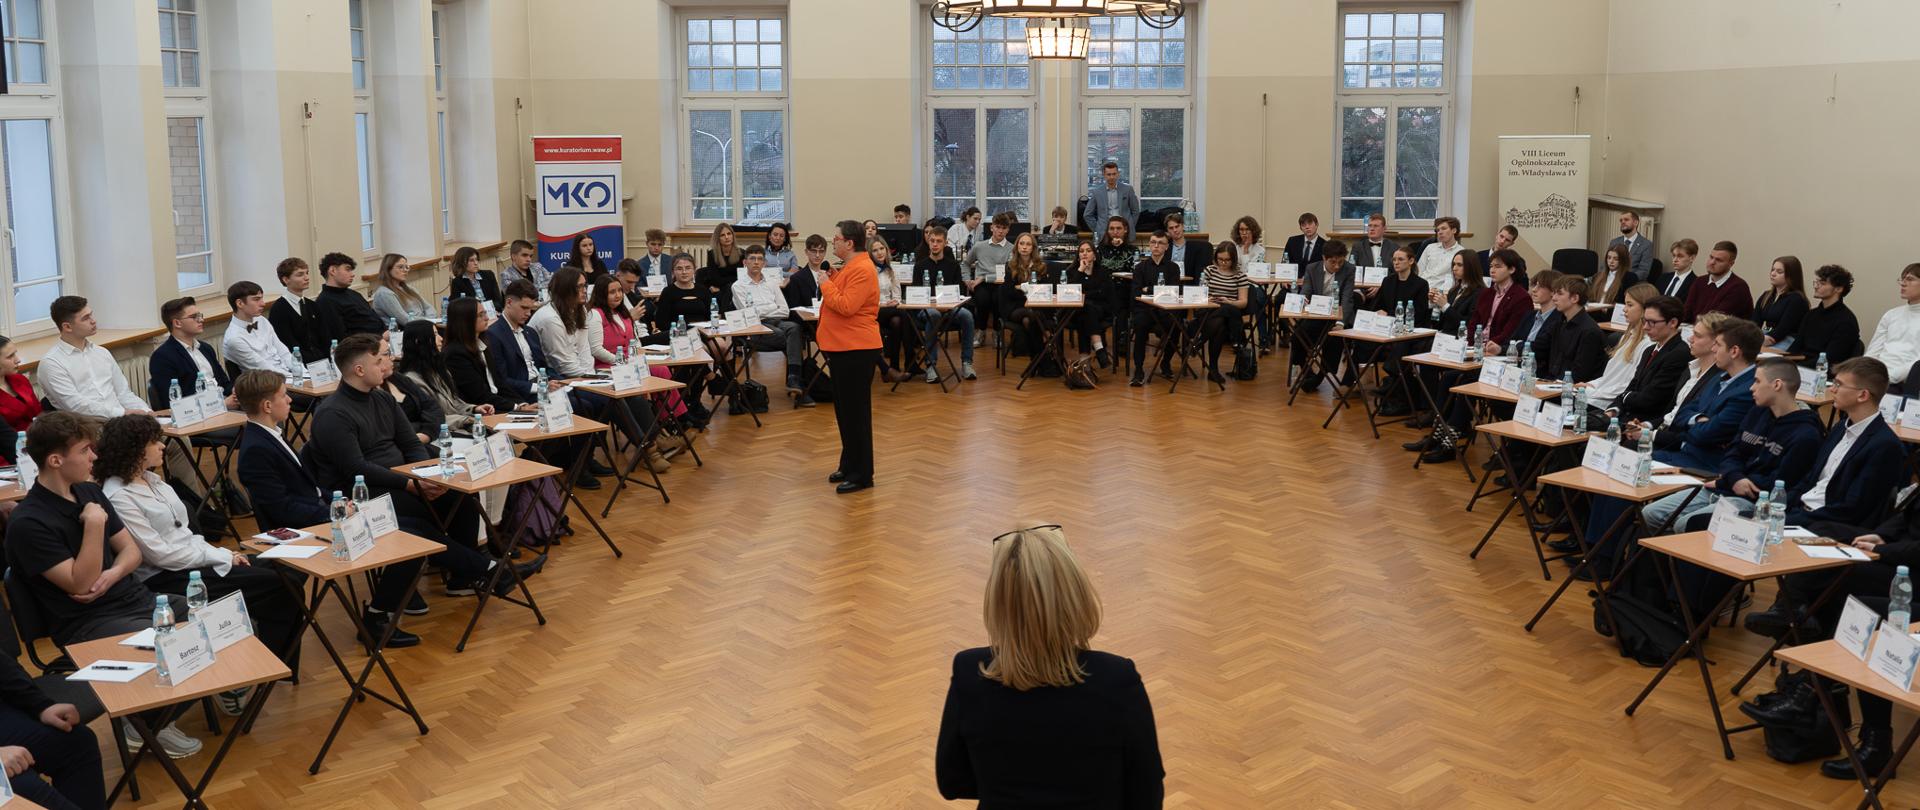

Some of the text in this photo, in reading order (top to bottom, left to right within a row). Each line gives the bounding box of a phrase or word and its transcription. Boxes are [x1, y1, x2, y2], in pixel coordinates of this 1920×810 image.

[1511, 159, 1576, 168] Ogólnokształcące
[1522, 169, 1567, 178] Władysława
[547, 181, 611, 208] MKO
[550, 250, 612, 260] KURUM
[179, 645, 200, 660] Bartosz
